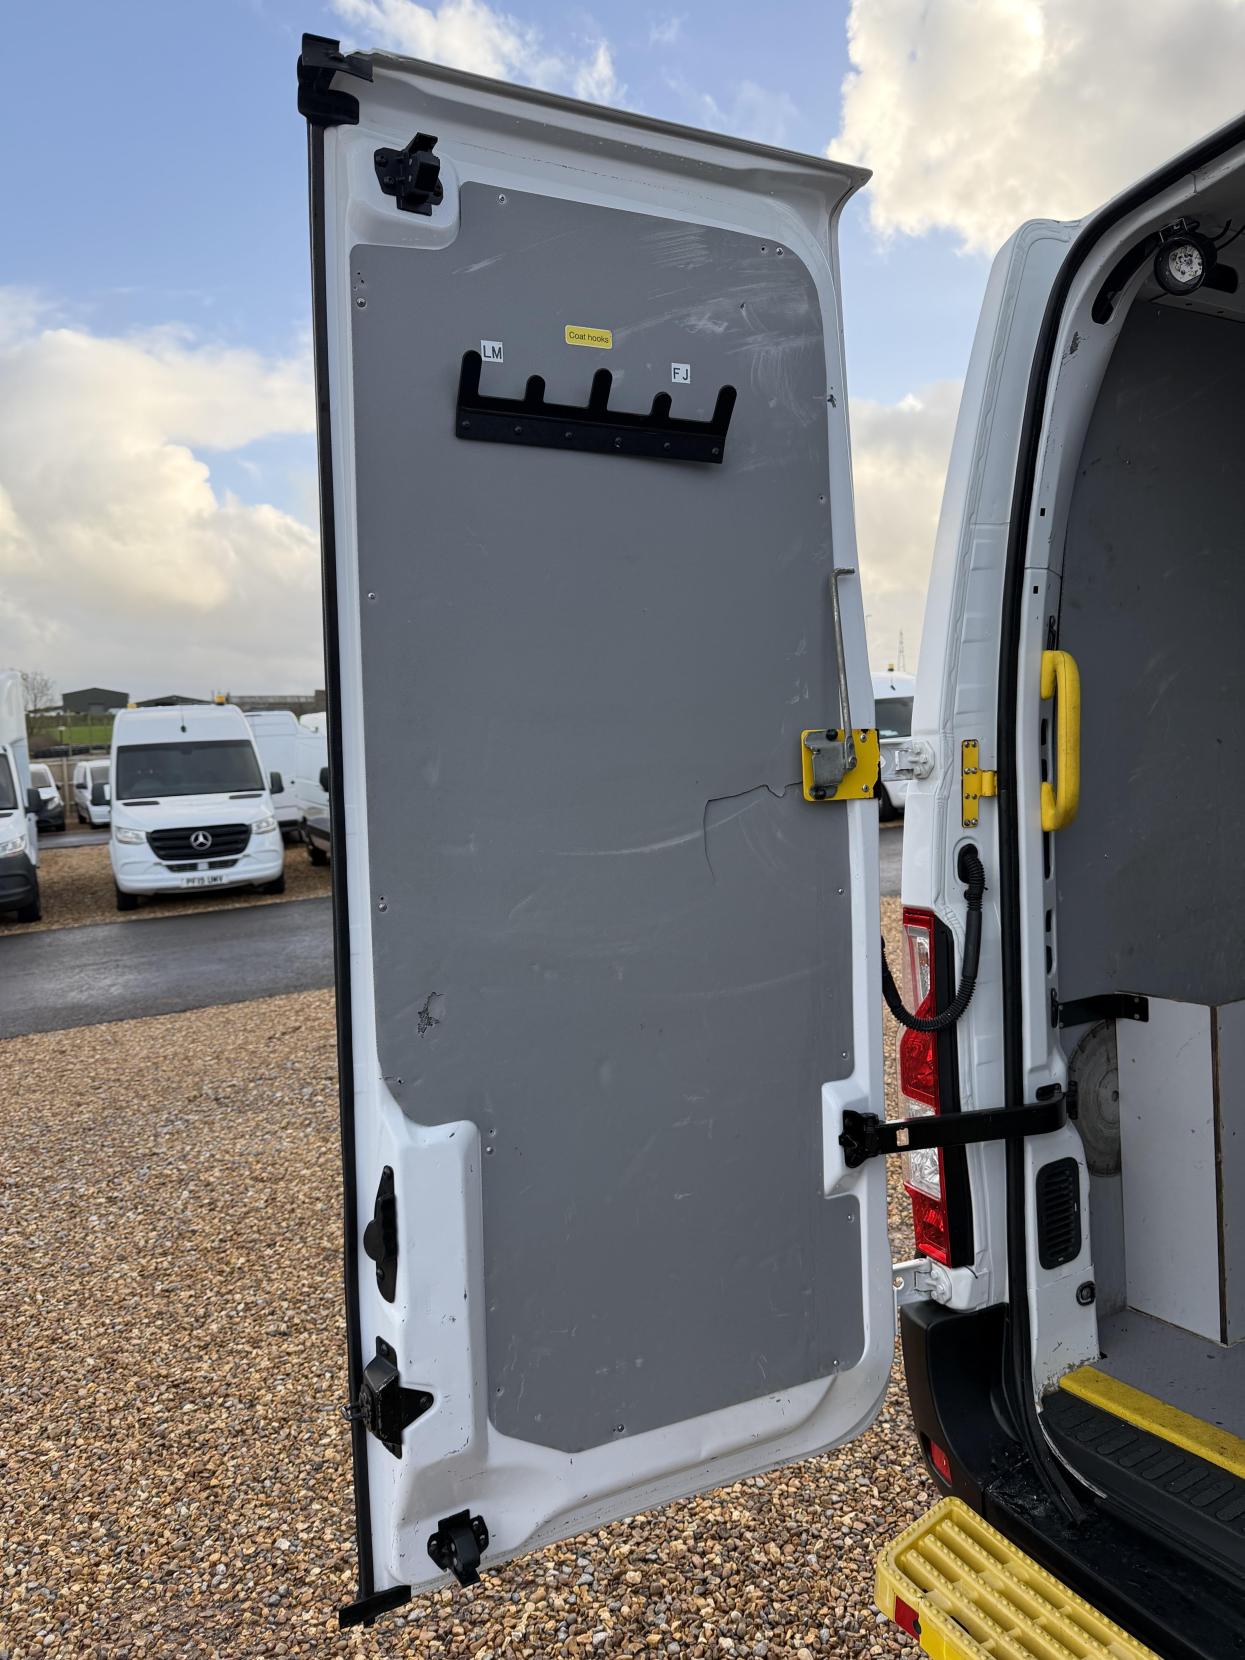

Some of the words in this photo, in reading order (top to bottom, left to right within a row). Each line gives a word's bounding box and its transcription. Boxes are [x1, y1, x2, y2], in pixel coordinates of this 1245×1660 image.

[568, 331, 586, 341] Coat
[587, 333, 609, 344] hooks
[483, 344, 502, 360] LM
[673, 367, 689, 381] FJ
